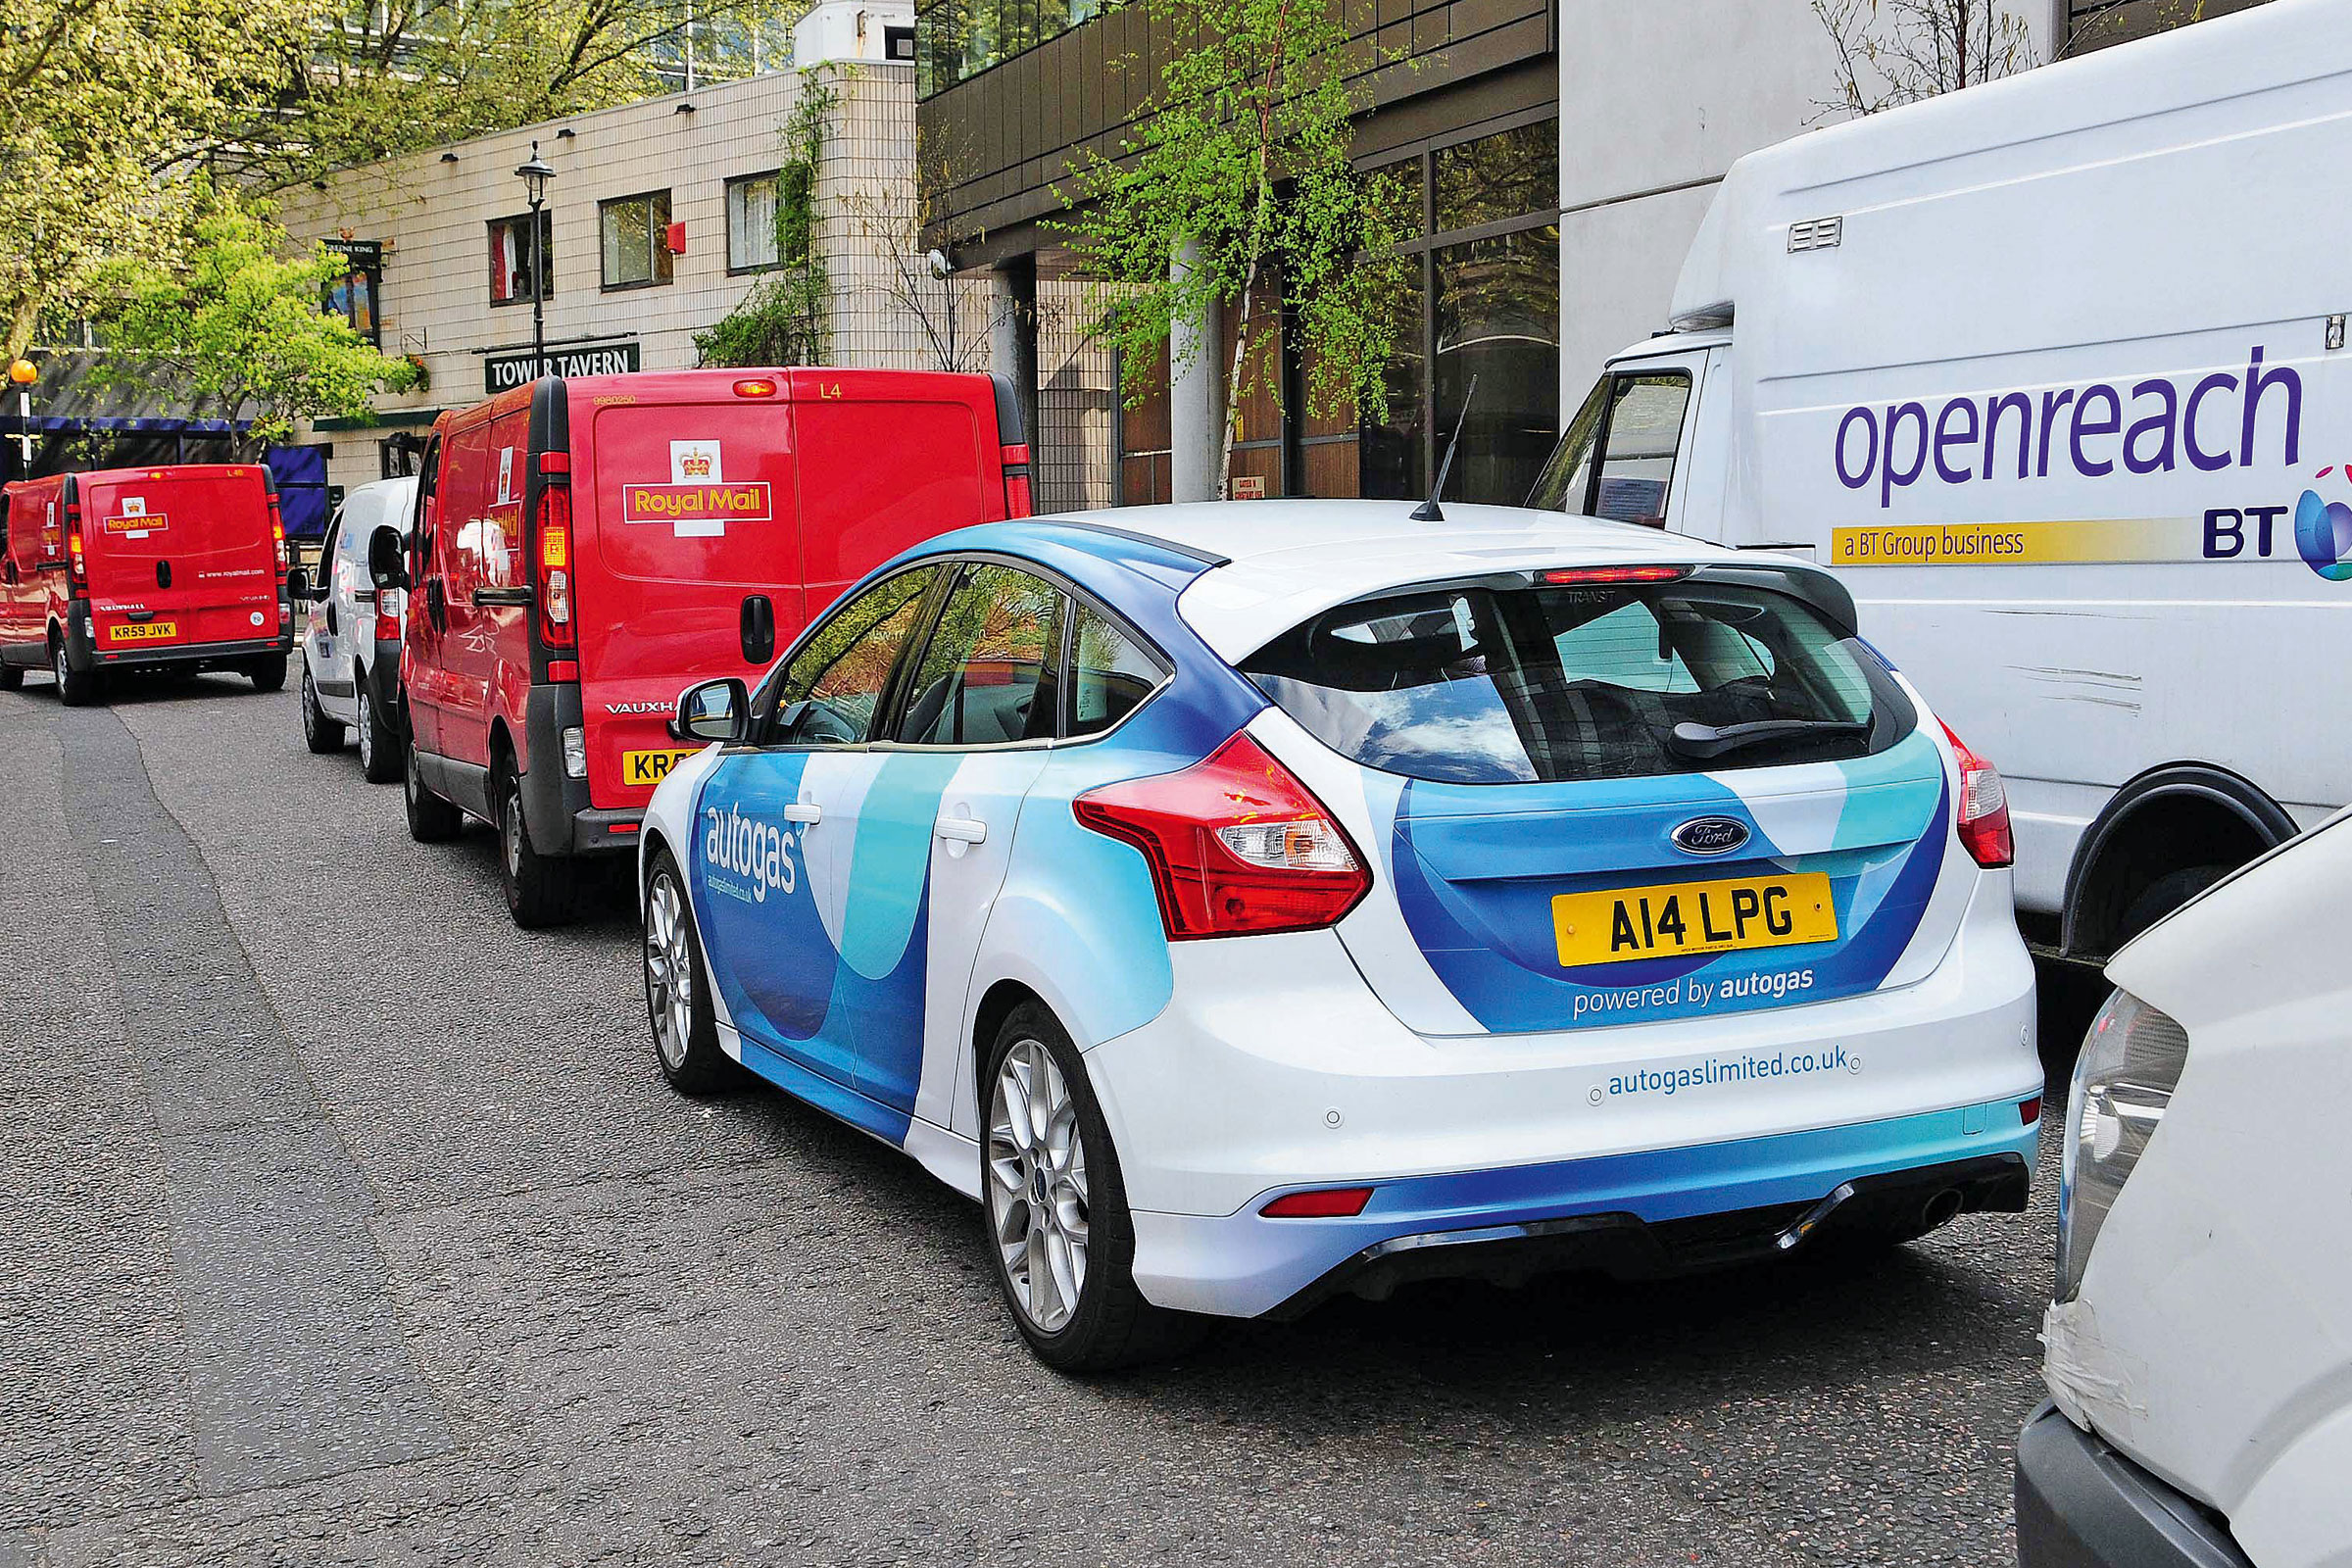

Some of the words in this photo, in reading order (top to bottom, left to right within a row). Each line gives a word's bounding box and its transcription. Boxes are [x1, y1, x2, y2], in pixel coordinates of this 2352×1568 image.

[558, 350, 628, 379] TAVERN
[819, 383, 842, 399] L4
[1835, 345, 2302, 508] openreach
[635, 490, 704, 516] Royal
[709, 488, 760, 511] Mail
[109, 519, 139, 530] Royal
[140, 516, 163, 527] Mail
[2202, 506, 2288, 560] BT
[1844, 540, 1855, 556] a
[1859, 533, 1879, 556] BT
[1883, 530, 1936, 562] Group
[1942, 526, 2024, 556] business
[114, 626, 146, 638] KR59
[148, 623, 172, 636] JVK
[707, 801, 796, 903] autogas
[1691, 824, 1734, 845] Ford
[1698, 886, 1793, 943] LPG
[1573, 977, 1680, 1019] powered
[1688, 975, 1715, 1008] by
[1720, 967, 1813, 1000] autogas
[1608, 1045, 1847, 1097] autogaslimited.co.uk
